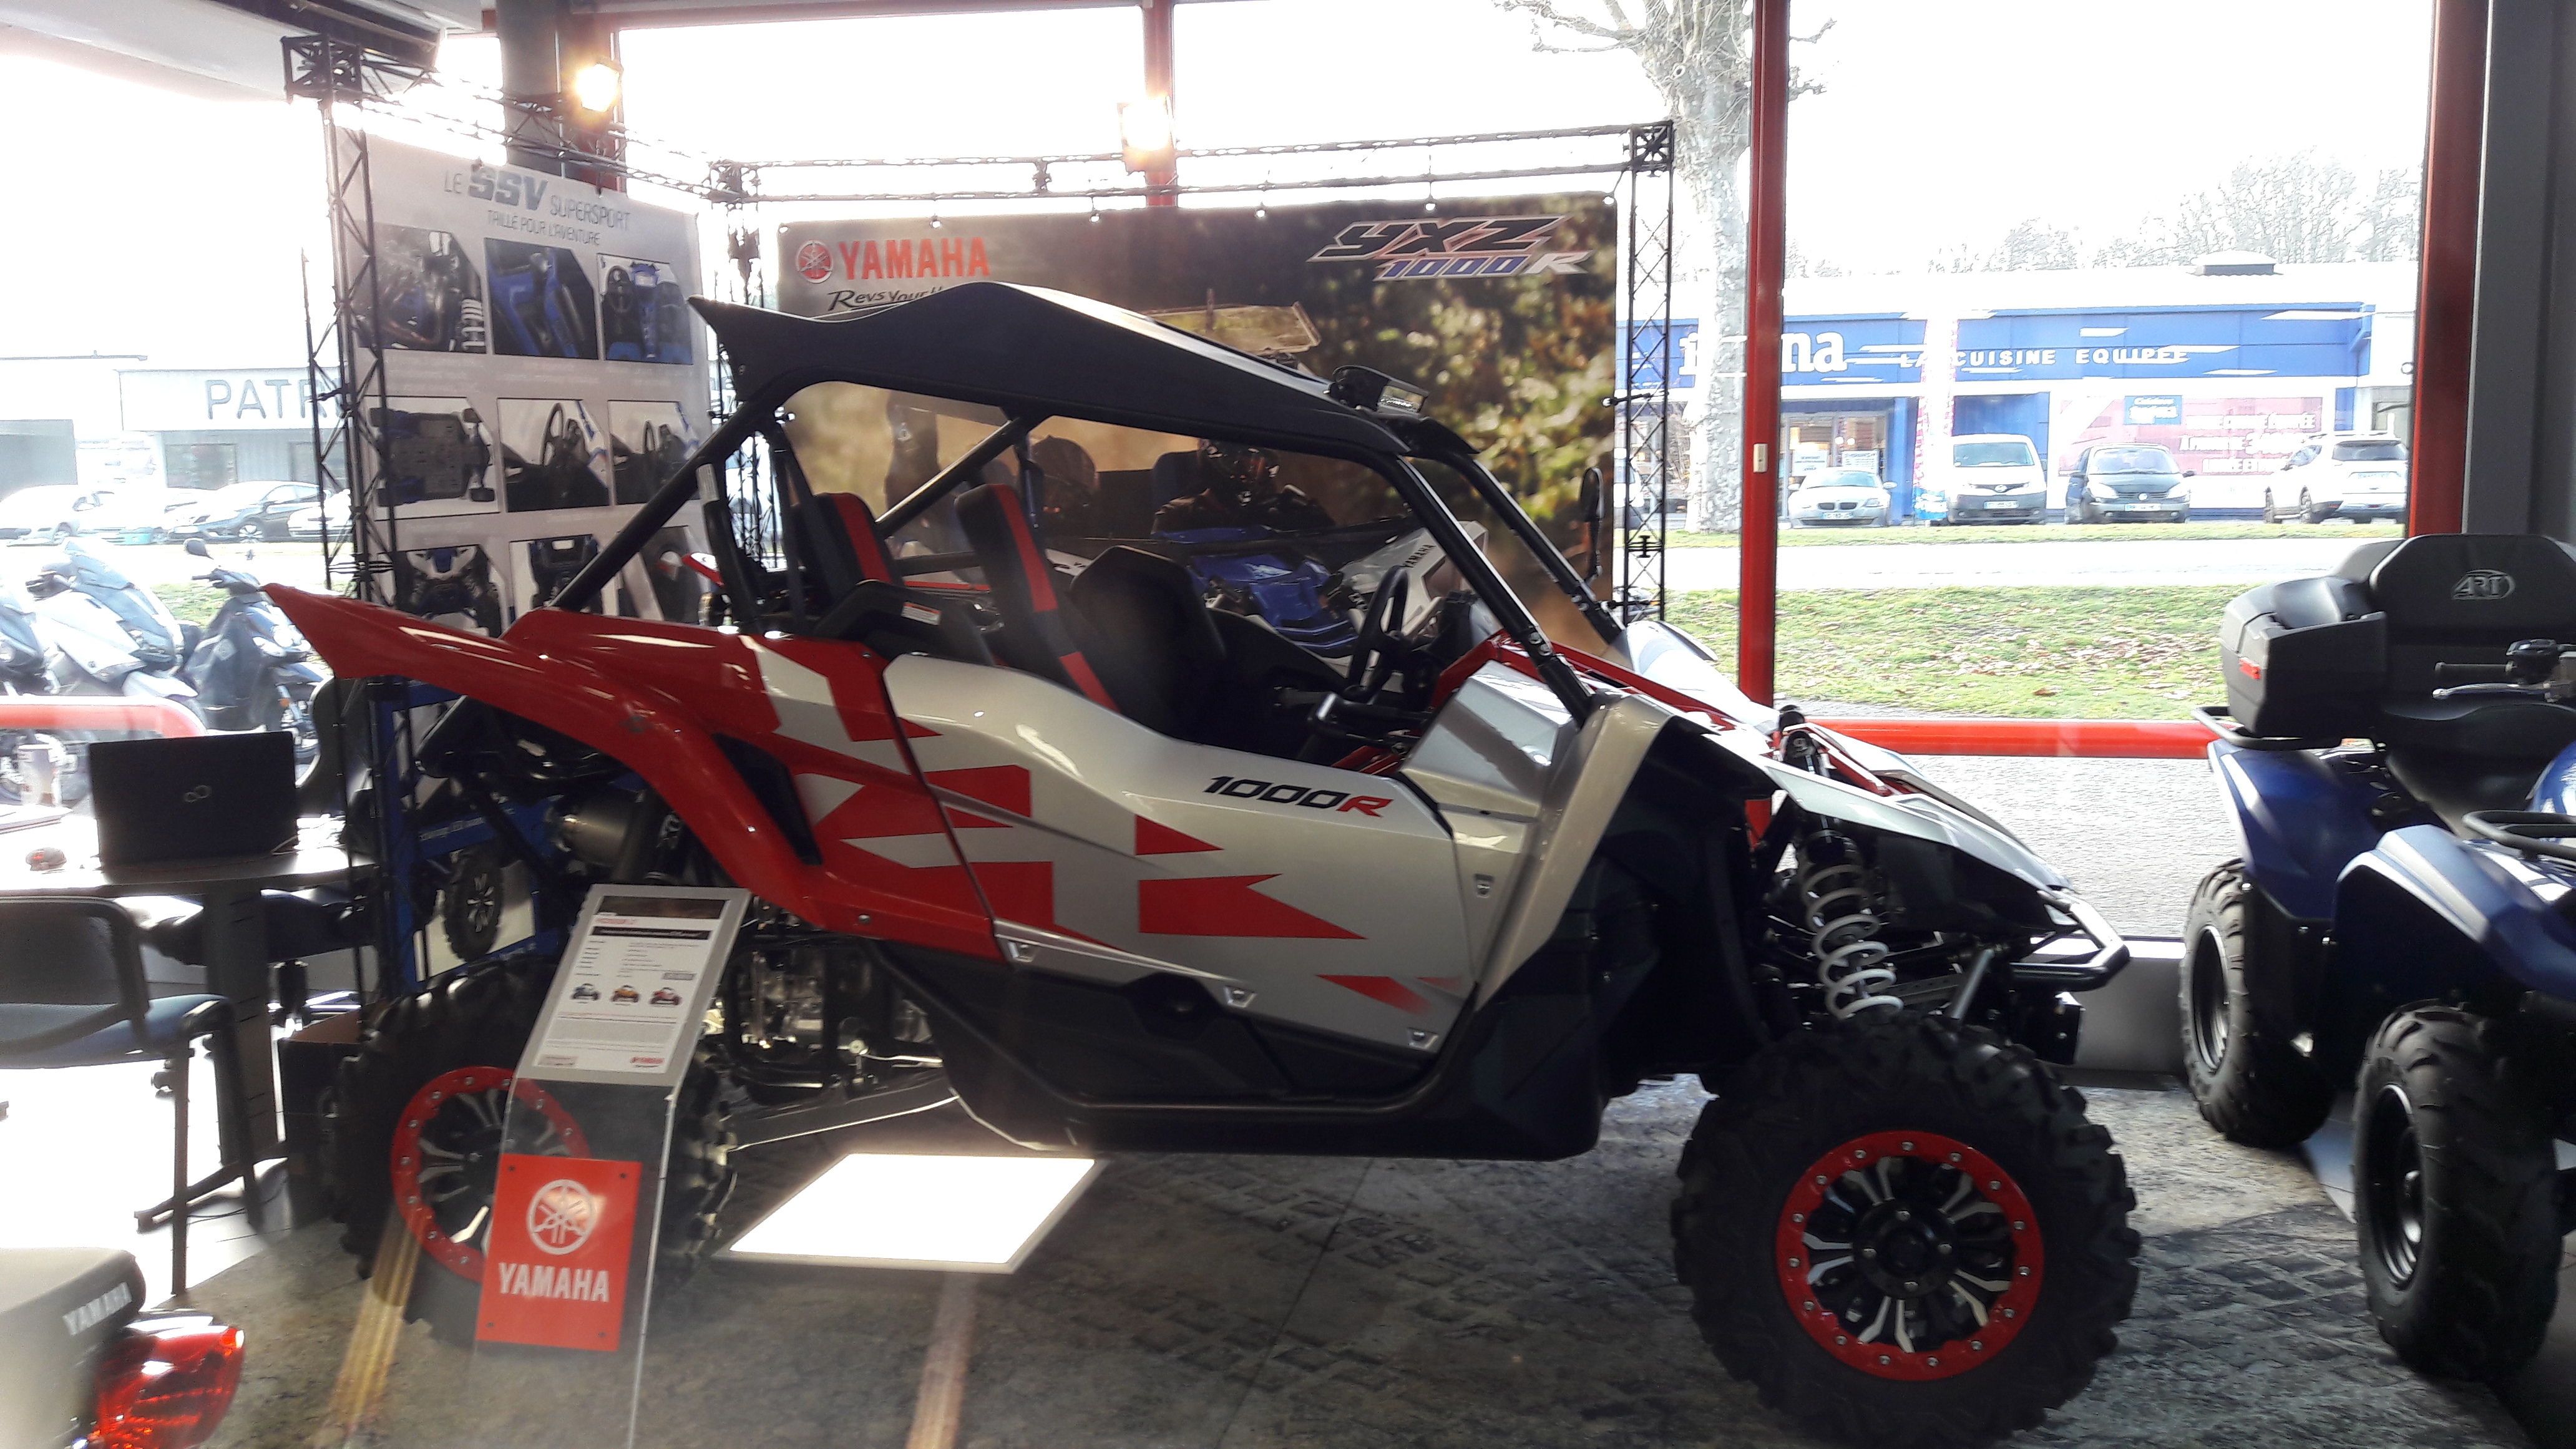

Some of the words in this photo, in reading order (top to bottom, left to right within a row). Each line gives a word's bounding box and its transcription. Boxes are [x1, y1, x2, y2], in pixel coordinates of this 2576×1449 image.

[444, 170, 463, 195] LE
[469, 166, 549, 211] SSV
[550, 194, 631, 231] SUPERSPORT
[520, 217, 547, 235] POUR
[838, 237, 990, 280] YAMAHA
[1373, 251, 1591, 281] 1000R
[1952, 349, 2057, 367] CUISINE
[1203, 776, 1395, 817] 1000R
[499, 1262, 610, 1303] YAMAHA
[62, 1281, 132, 1336] YAMAHA
